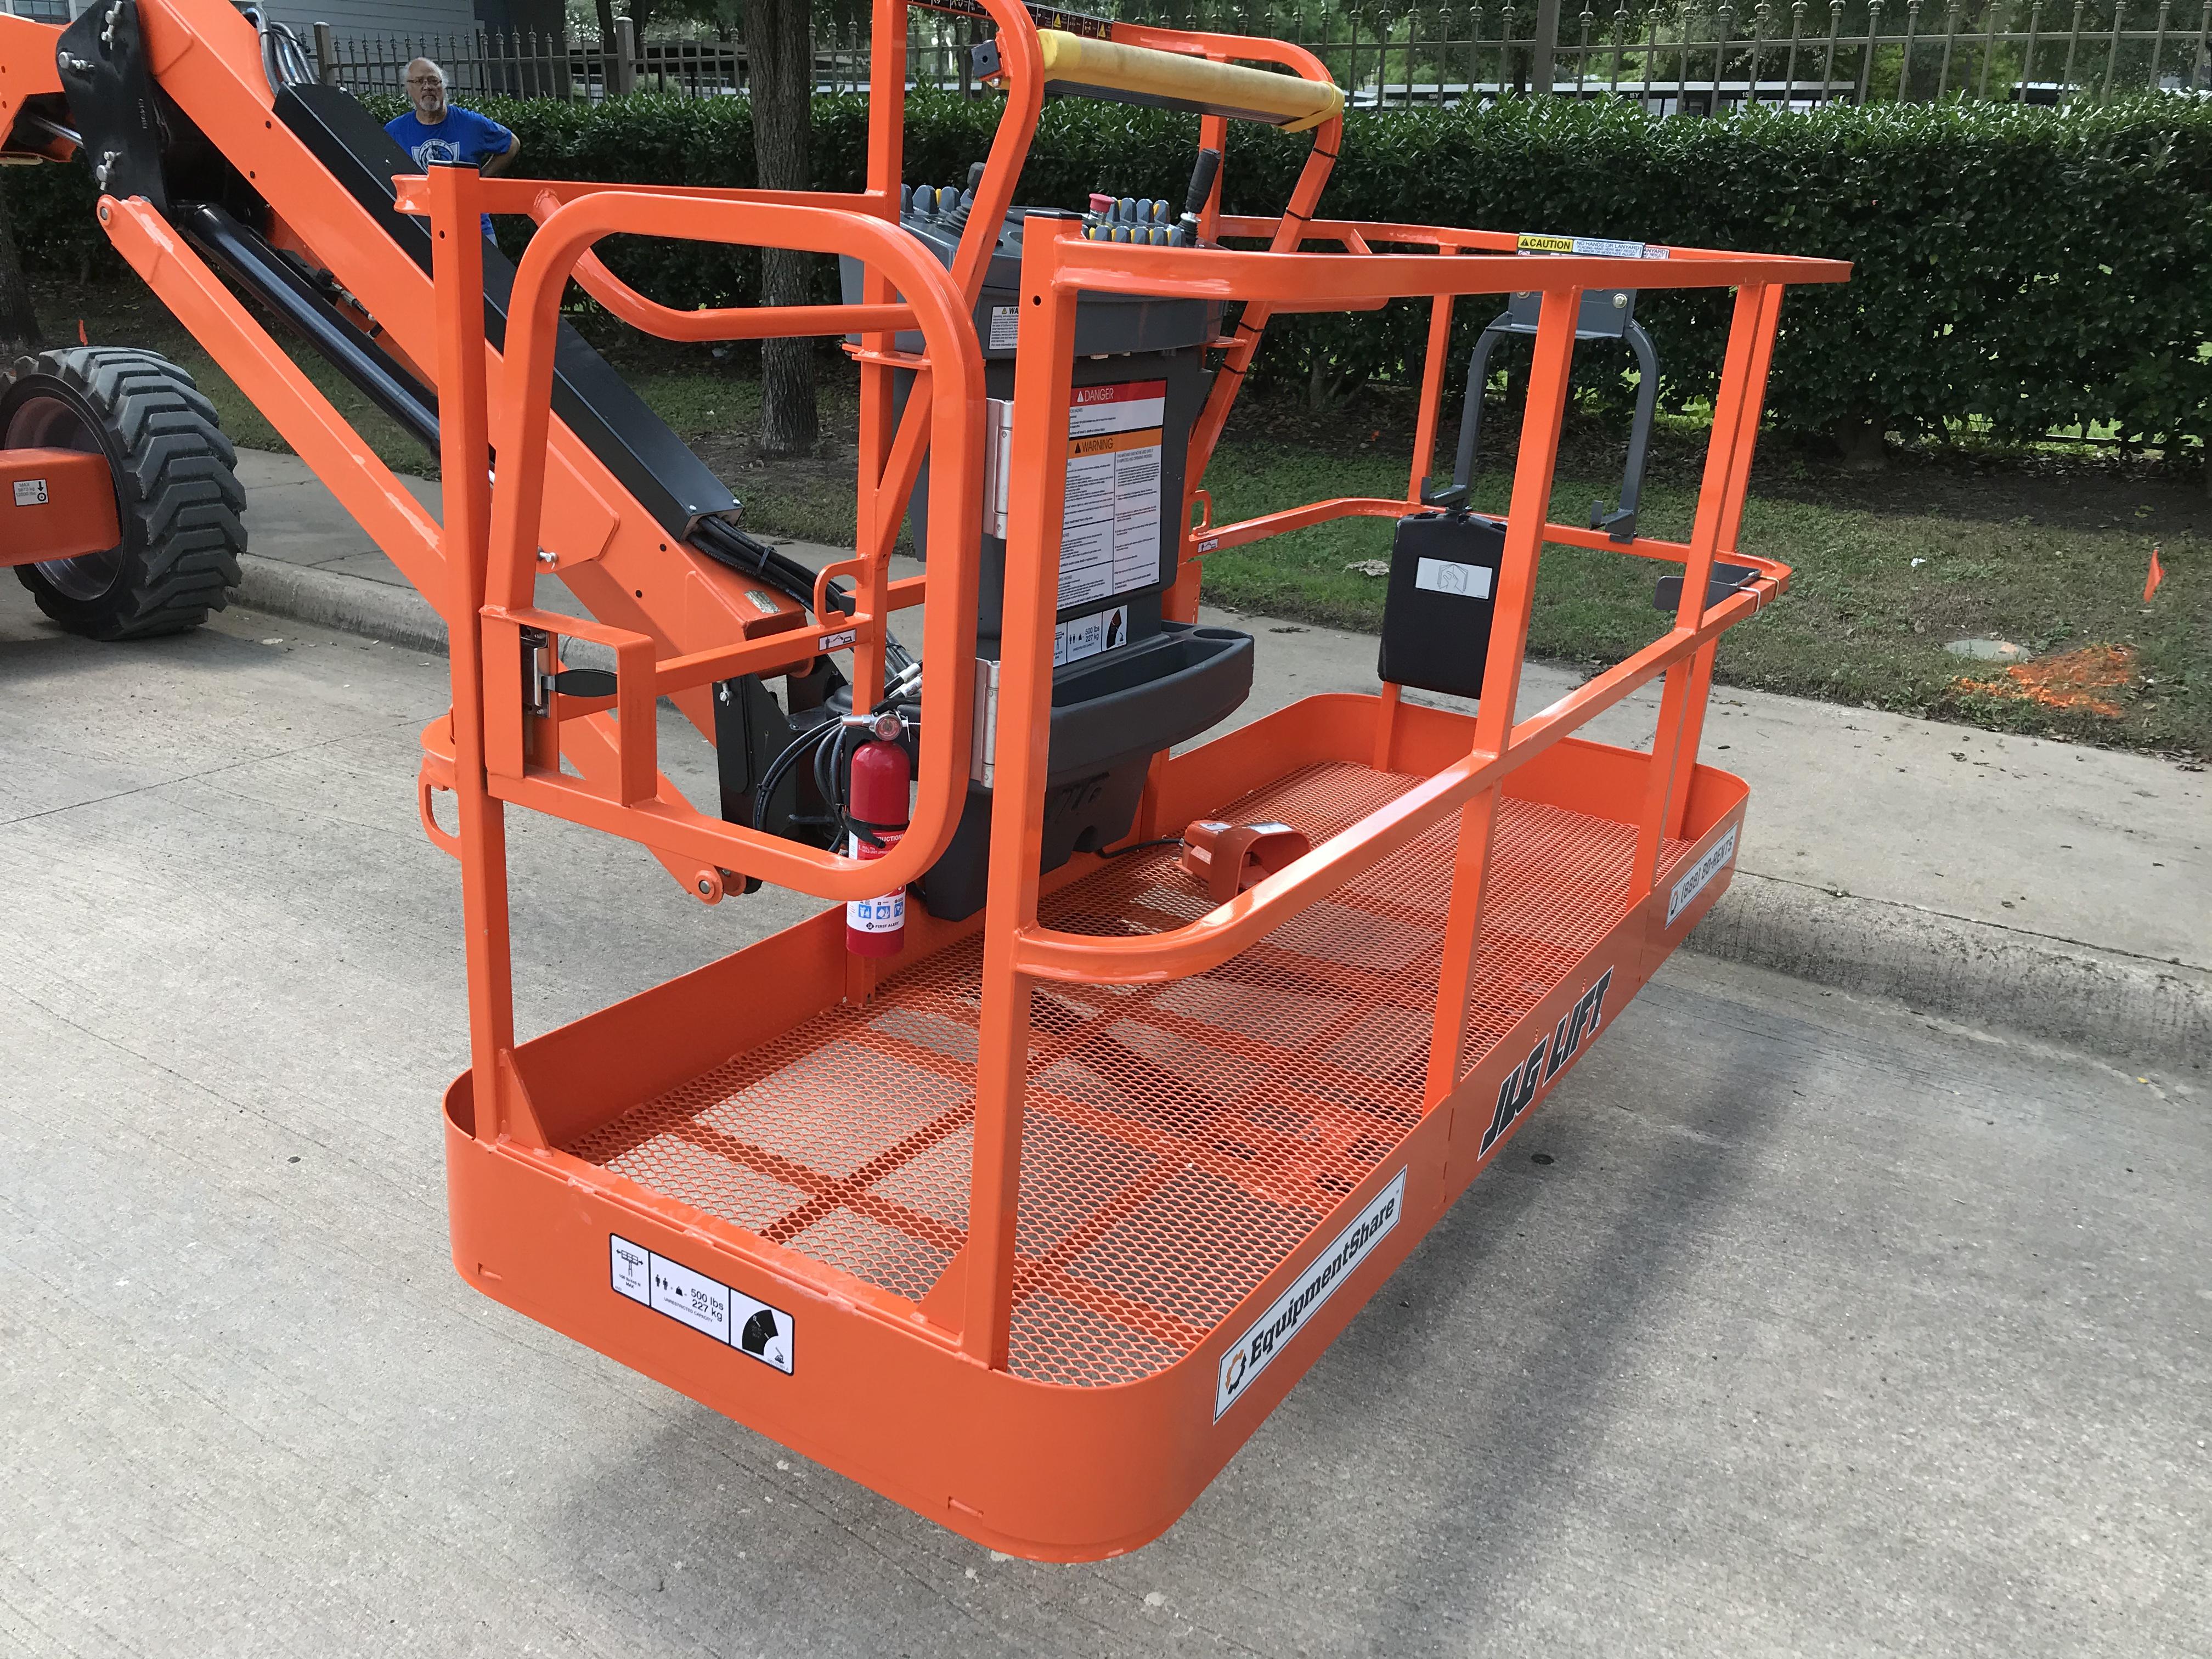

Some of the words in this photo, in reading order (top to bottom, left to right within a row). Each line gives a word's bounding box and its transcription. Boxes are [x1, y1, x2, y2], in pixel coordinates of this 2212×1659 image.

[1530, 239, 1571, 250] CAUTION
[1085, 388, 1114, 402] DANGER
[1081, 438, 1114, 453] WARNING
[1477, 1033, 1550, 1162] JLG
[1542, 964, 1614, 1088] LIFT
[1249, 1197, 1396, 1369] EquipmentShare
[691, 1288, 708, 1303] 500
[709, 1296, 724, 1311] lbs
[692, 1299, 709, 1313] 227
[711, 1308, 723, 1322] kg
